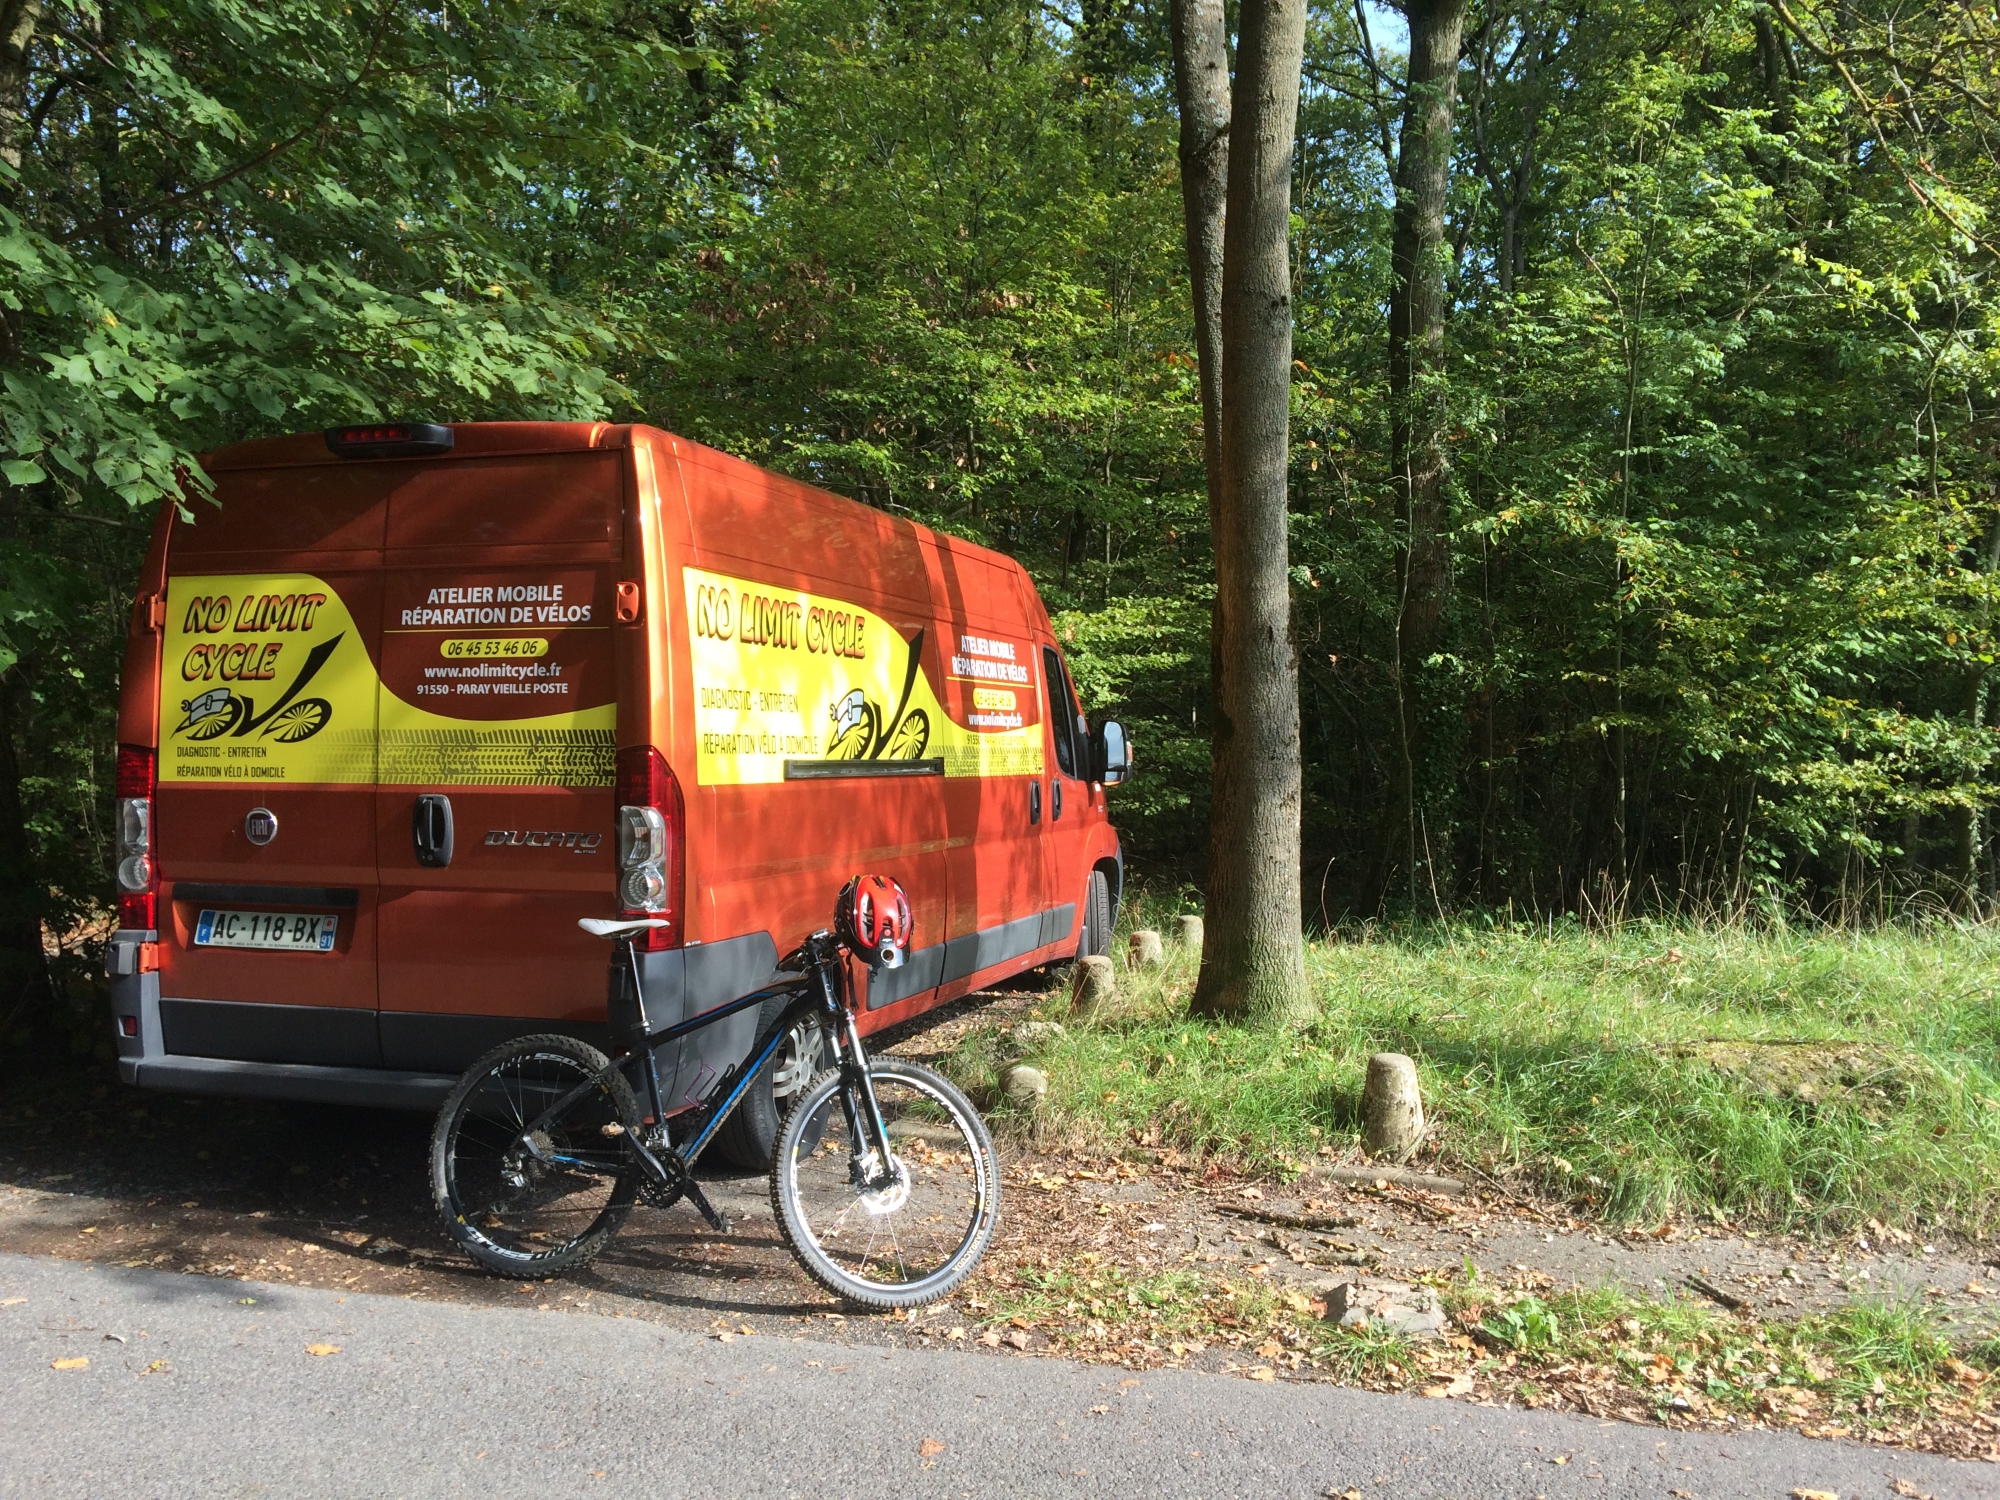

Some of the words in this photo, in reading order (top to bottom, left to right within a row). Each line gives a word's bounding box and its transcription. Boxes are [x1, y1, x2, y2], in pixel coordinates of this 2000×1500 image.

[427, 587, 493, 604] ATELIER
[497, 585, 563, 602] MOBILE
[183, 595, 232, 633] NO
[233, 593, 327, 632] LIMIT
[401, 607, 506, 625] RÉPARATION
[510, 606, 533, 623] DE
[536, 603, 591, 622] VÉLOS
[697, 584, 735, 641] NO
[740, 592, 802, 650] LIMIT
[806, 606, 865, 660] CYCLE
[447, 642, 463, 656] 06
[466, 642, 482, 655] 45
[484, 641, 500, 655] 53
[503, 641, 519, 655] 46
[522, 640, 538, 654] 06
[182, 643, 283, 681] CYCLE
[424, 662, 562, 680] www.nolimitcycle.fr
[416, 684, 449, 695] 91550
[457, 684, 490, 695] PARAY
[492, 683, 531, 694] VIEILLE
[533, 683, 568, 694] POSTE
[702, 687, 751, 710] DIAGNOSTIC
[760, 692, 799, 713] ENTRETIEN
[703, 729, 756, 754] RÉPARATION
[177, 746, 221, 758] DIAGNOSTIC
[228, 747, 267, 758] ENTRETIEN
[177, 764, 221, 778] RÉPARATION
[224, 765, 242, 778] VÉLO
[243, 764, 249, 777] À
[251, 766, 285, 778] DOMICILE
[250, 818, 272, 836] FIAT
[484, 830, 602, 848] DUCATO
[213, 914, 321, 943] AC-118-BX
[321, 935, 332, 947] 91
[982, 1154, 992, 1213] HUTCHINSON
